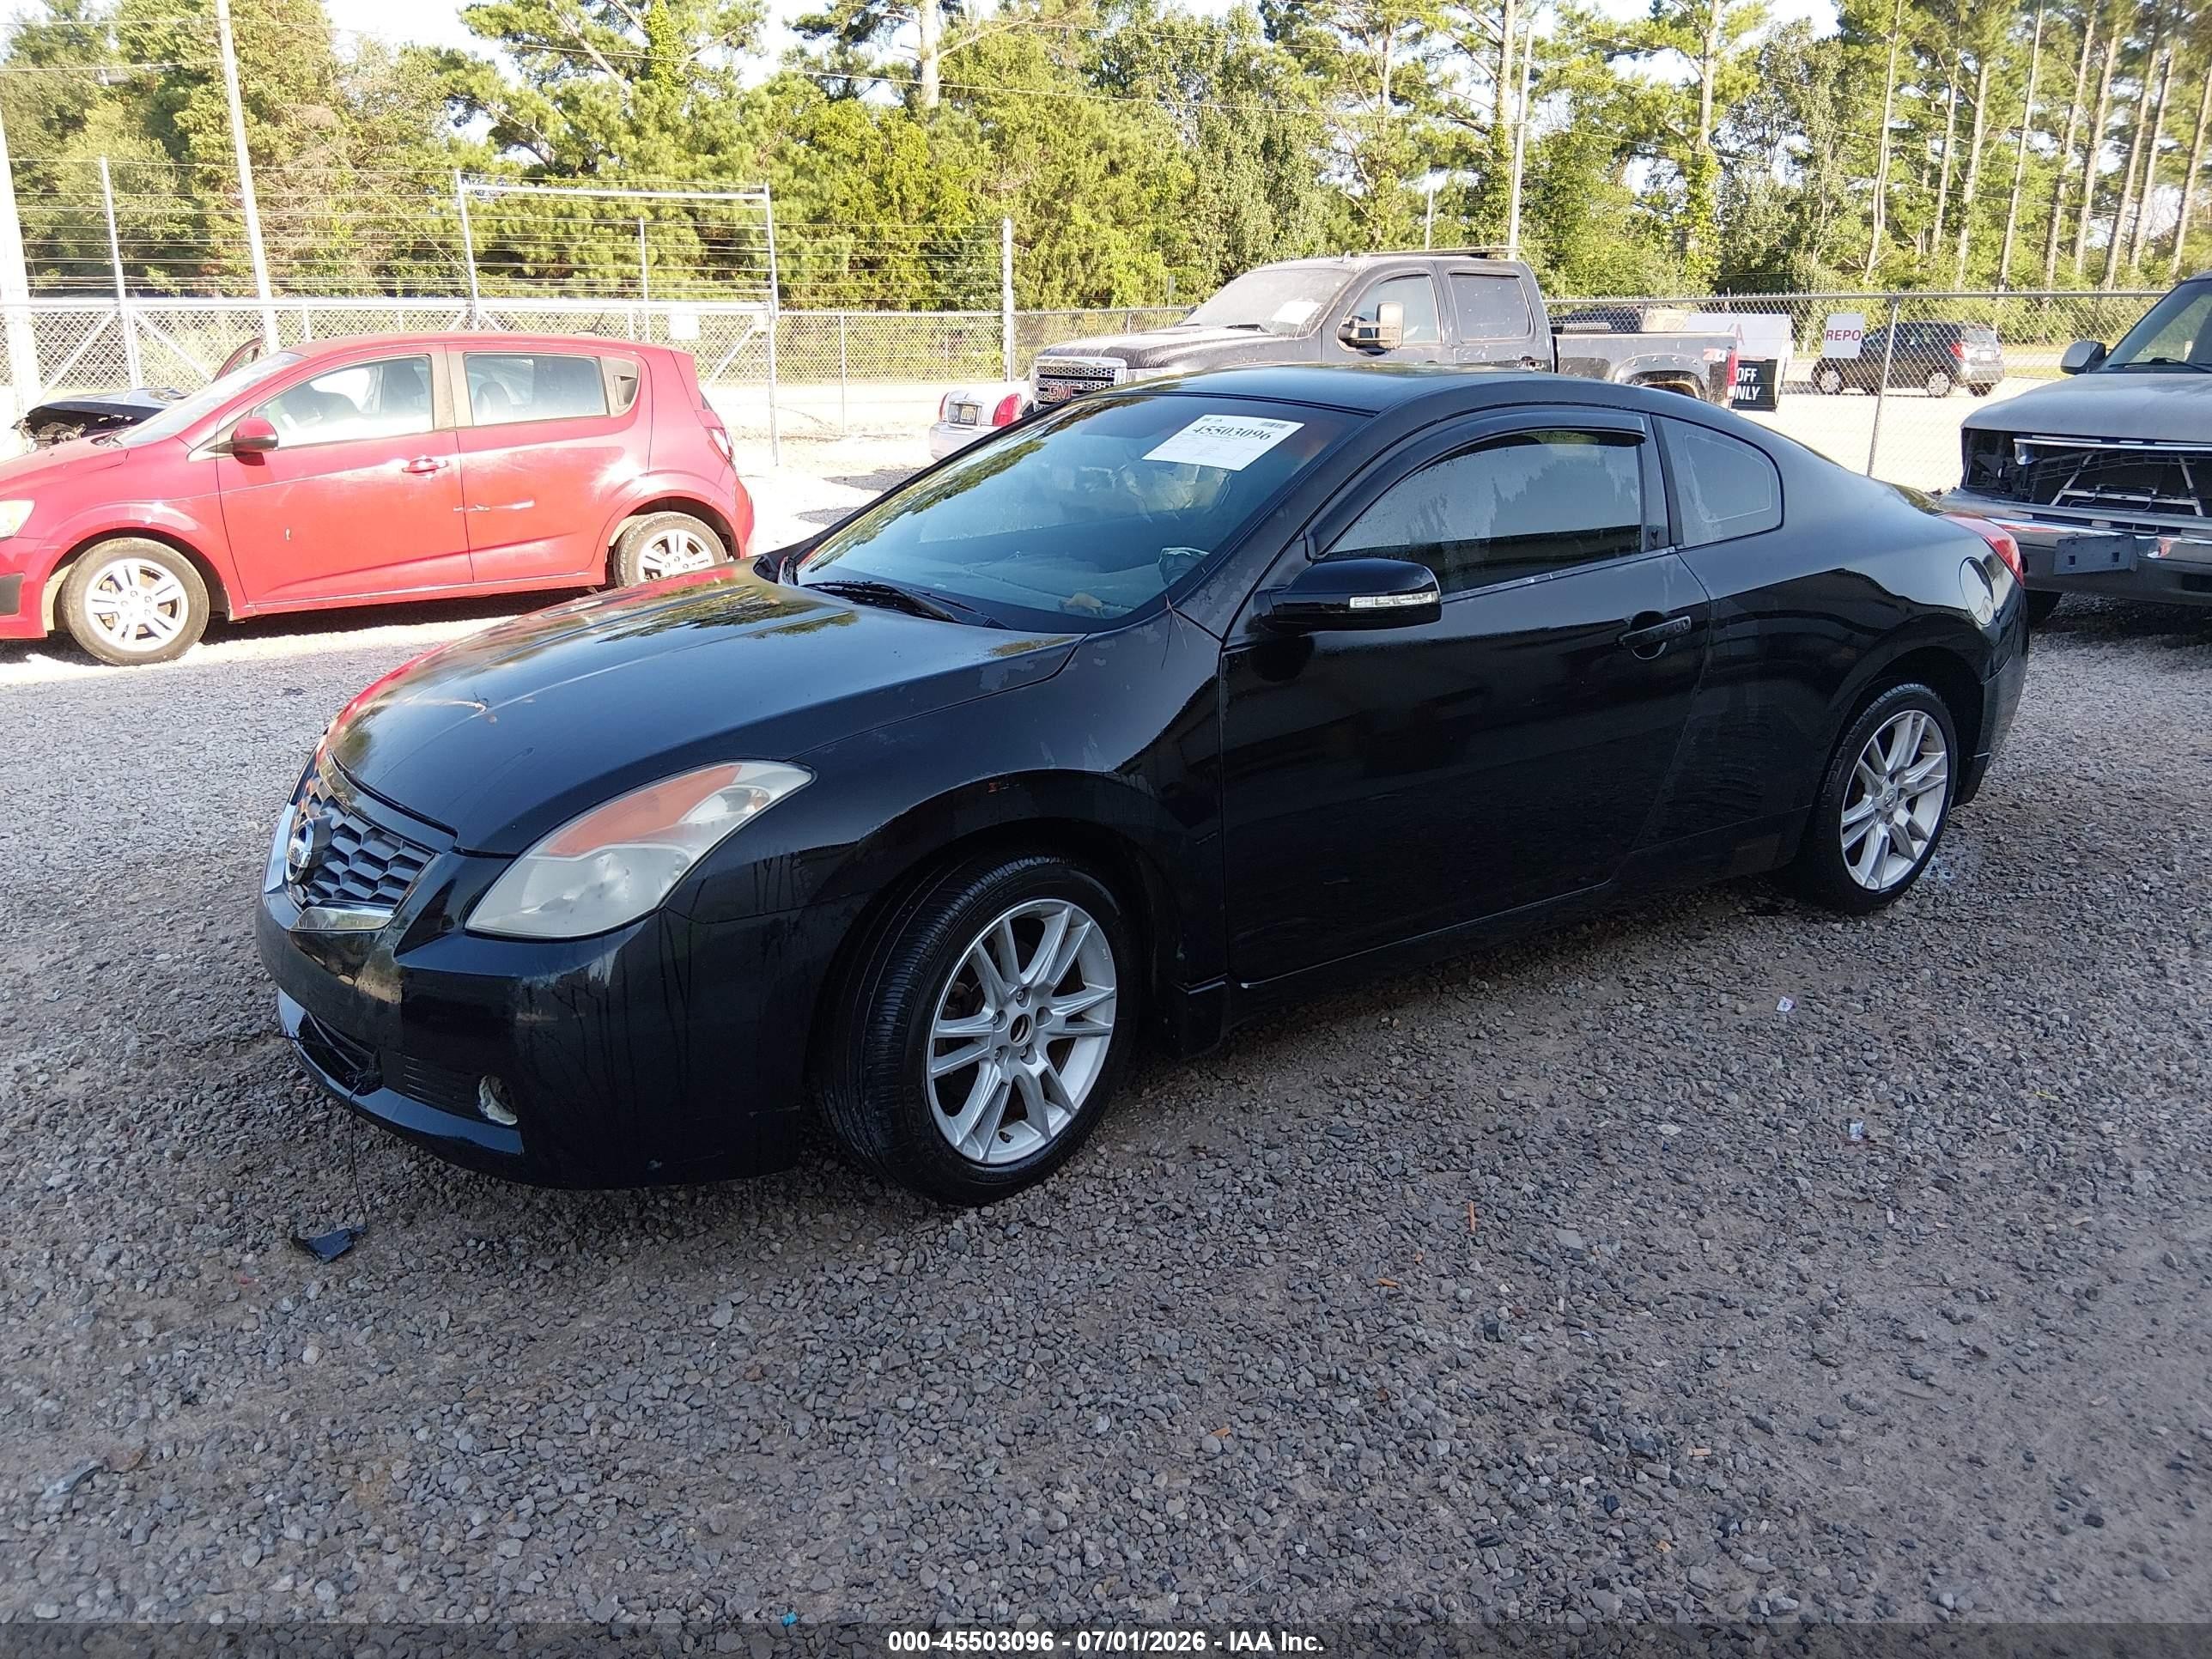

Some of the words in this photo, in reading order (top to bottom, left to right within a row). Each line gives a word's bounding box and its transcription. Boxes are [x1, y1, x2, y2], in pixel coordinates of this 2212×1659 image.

[1825, 329, 1862, 342] REPO
[1736, 367, 1759, 383] OFF
[1048, 384, 1081, 399] GMC
[1734, 385, 1761, 401] NLY
[1193, 425, 1276, 441] 45503096
